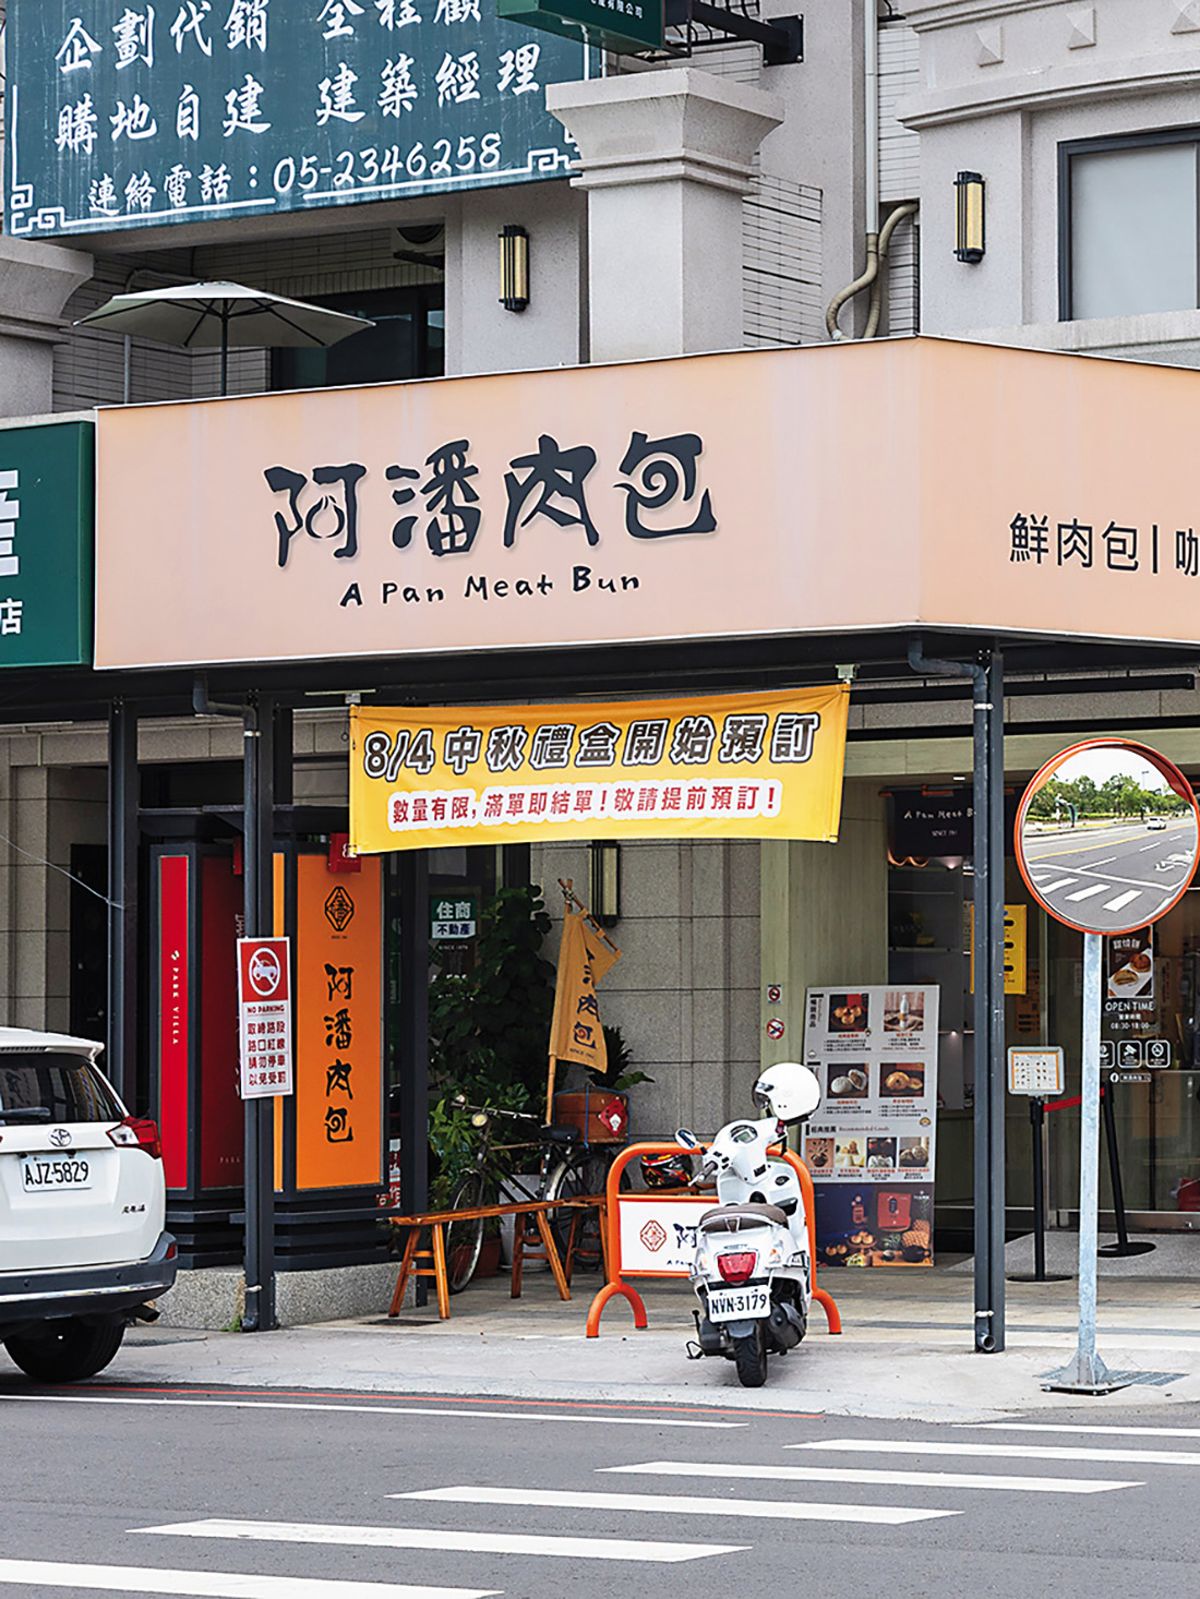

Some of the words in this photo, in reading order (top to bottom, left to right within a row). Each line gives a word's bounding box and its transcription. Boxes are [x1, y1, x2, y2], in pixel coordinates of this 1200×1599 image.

[54, 0, 269, 75] 企劃代銷
[54, 75, 272, 153] 購地自建
[316, 43, 541, 126] 建築經理
[263, 430, 717, 567] 阿潘肉包
[340, 583, 363, 607] A
[382, 583, 444, 605] Pan
[464, 574, 553, 601] Meat
[573, 565, 640, 592] Bun
[436, 901, 471, 919] 住商
[437, 923, 470, 935] 不動產
[1105, 1001, 1131, 1011] OPEN
[1133, 1001, 1154, 1011] TIME
[323, 963, 354, 1143] 阿潘肉包
[25, 1161, 90, 1186] AJZ-5829
[711, 1294, 768, 1315] NVN-3179
